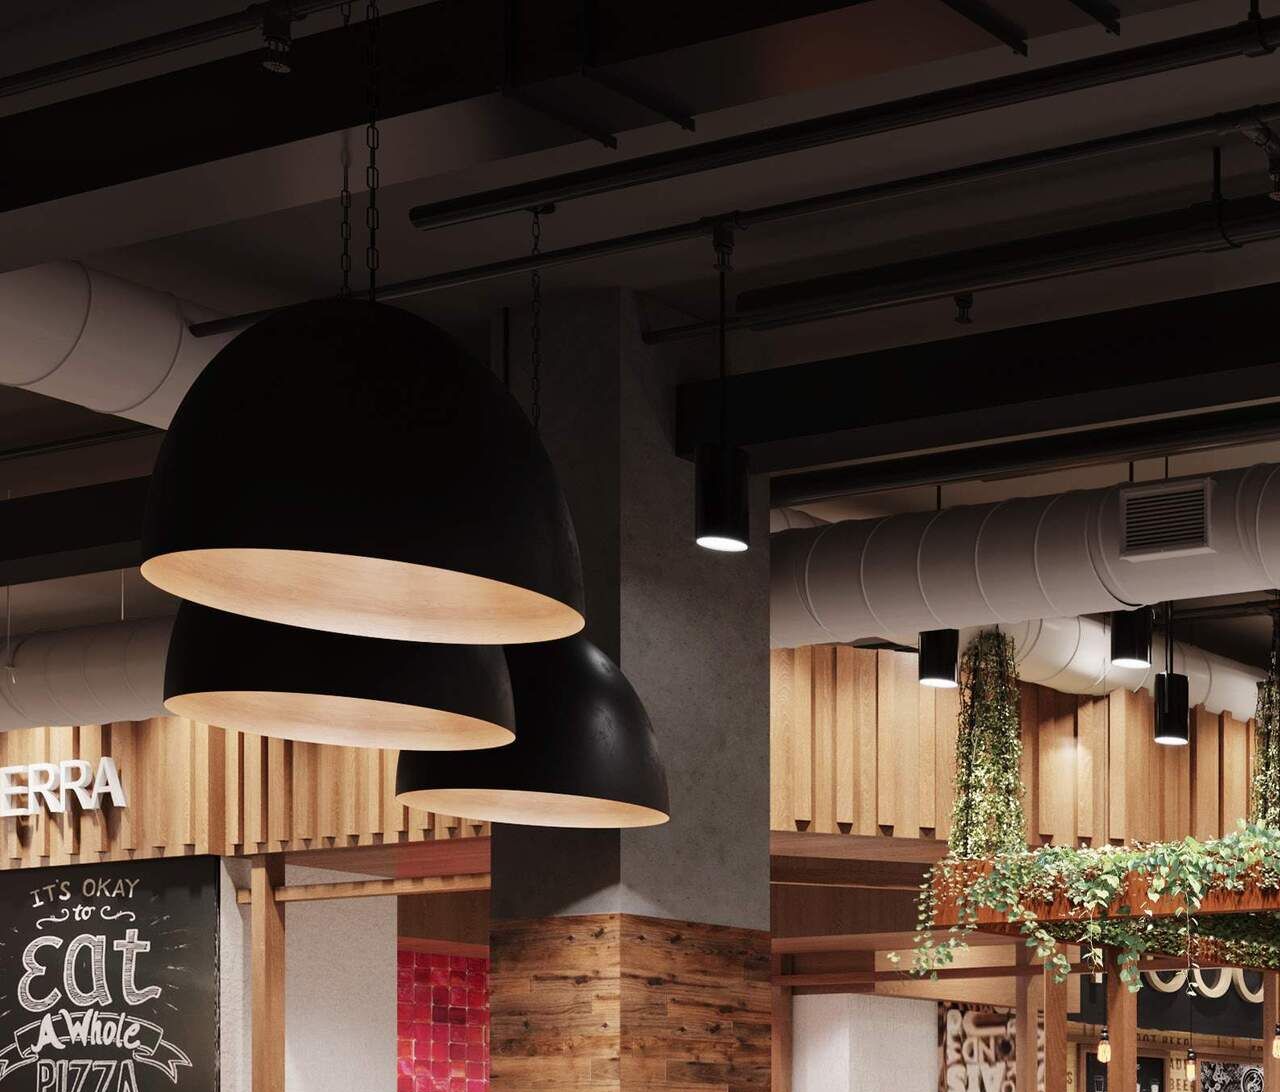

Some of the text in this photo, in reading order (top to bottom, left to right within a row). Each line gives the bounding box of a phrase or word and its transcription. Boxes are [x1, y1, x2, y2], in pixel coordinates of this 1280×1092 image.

[0, 757, 128, 817] ERRA
[30, 877, 141, 908] IT'S OKAY
[72, 903, 96, 921] to
[31, 1008, 142, 1051] A Whole
[1169, 1078, 1193, 1092] BEE
